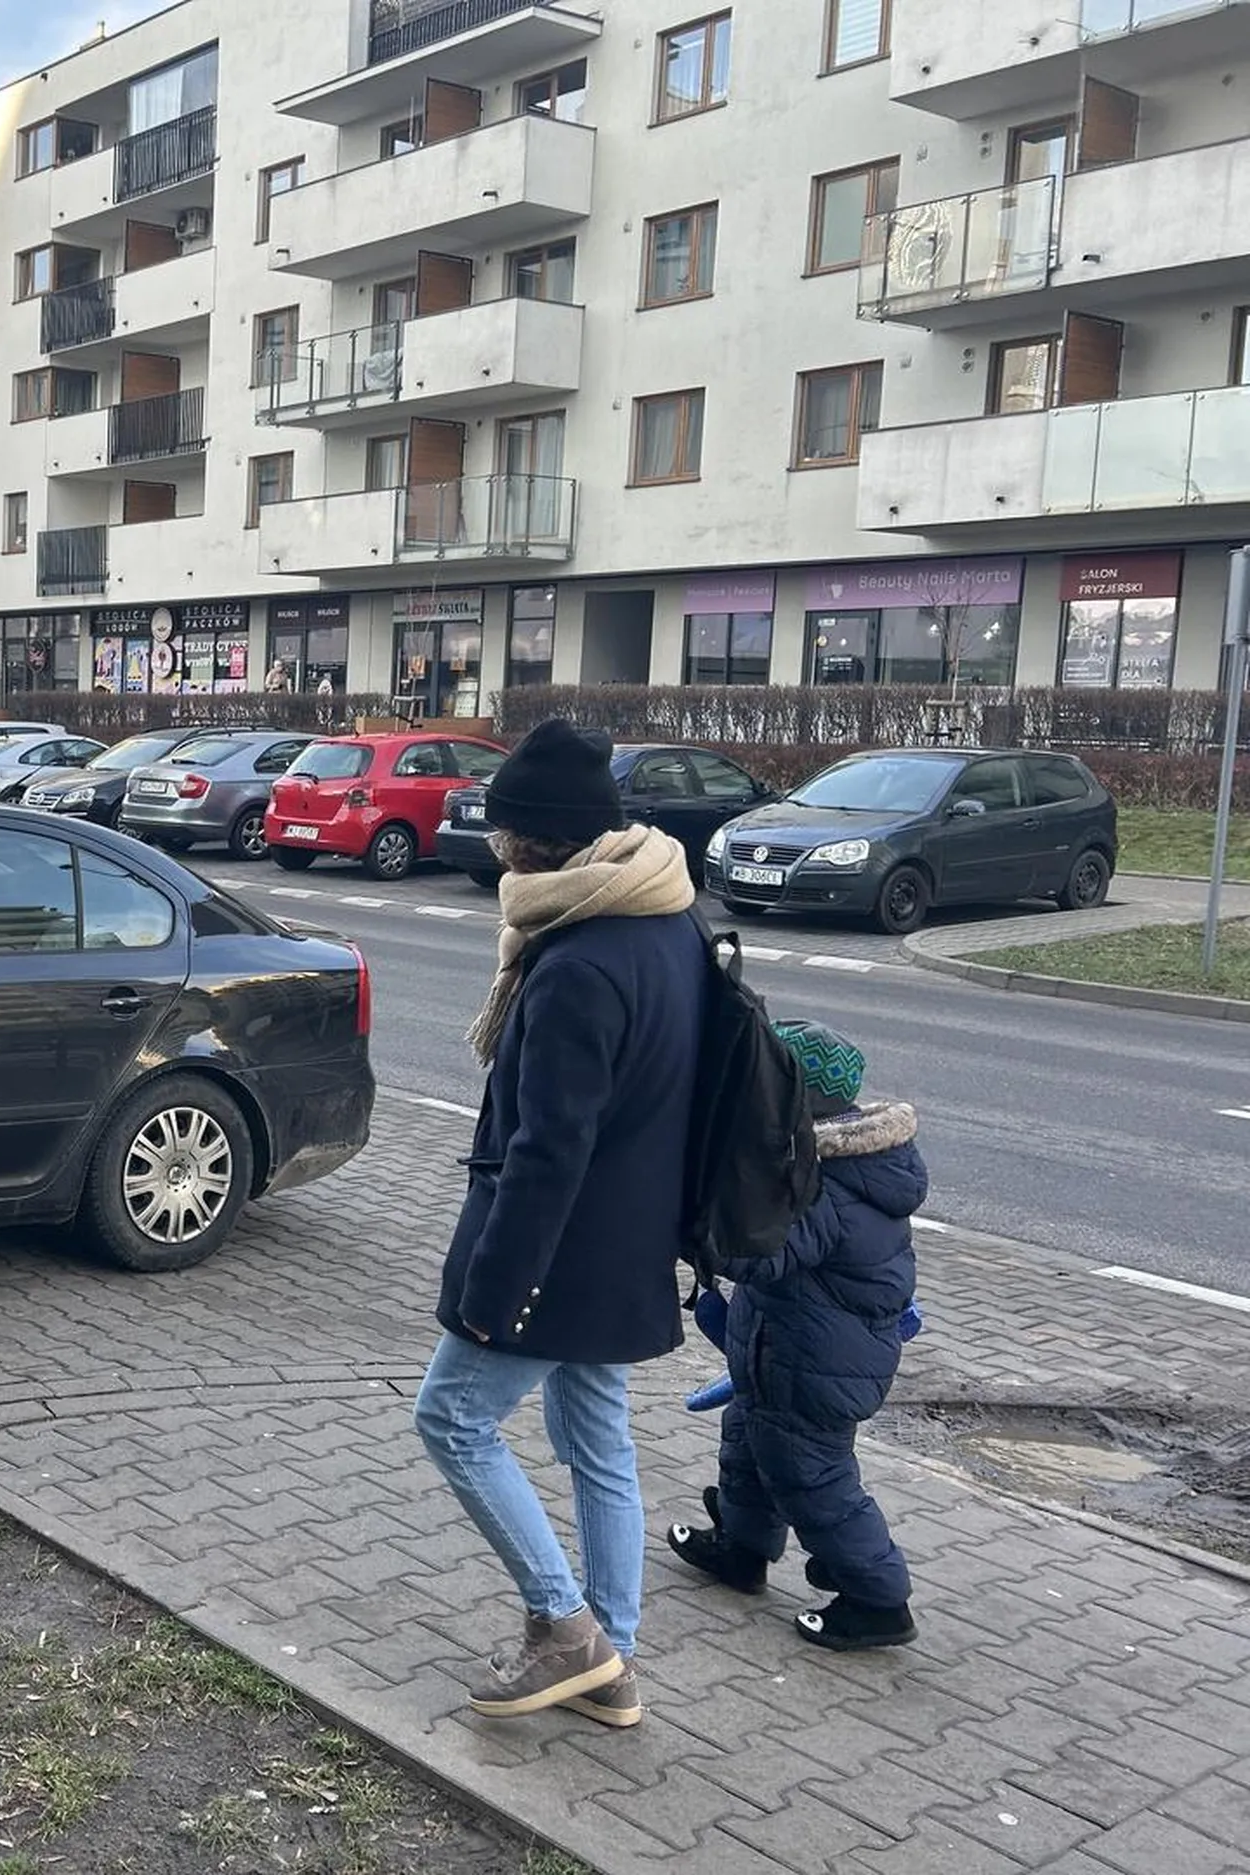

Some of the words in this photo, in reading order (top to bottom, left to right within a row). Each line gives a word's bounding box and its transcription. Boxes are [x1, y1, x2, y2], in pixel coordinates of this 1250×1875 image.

[859, 575, 912, 591] Beauty
[918, 572, 956, 586] Nails
[961, 570, 1011, 585] Marta
[1080, 569, 1118, 580] SALON
[1078, 583, 1144, 595] FRYZJERSKI
[98, 610, 148, 621] STOLICA
[186, 604, 242, 616] STOLICA
